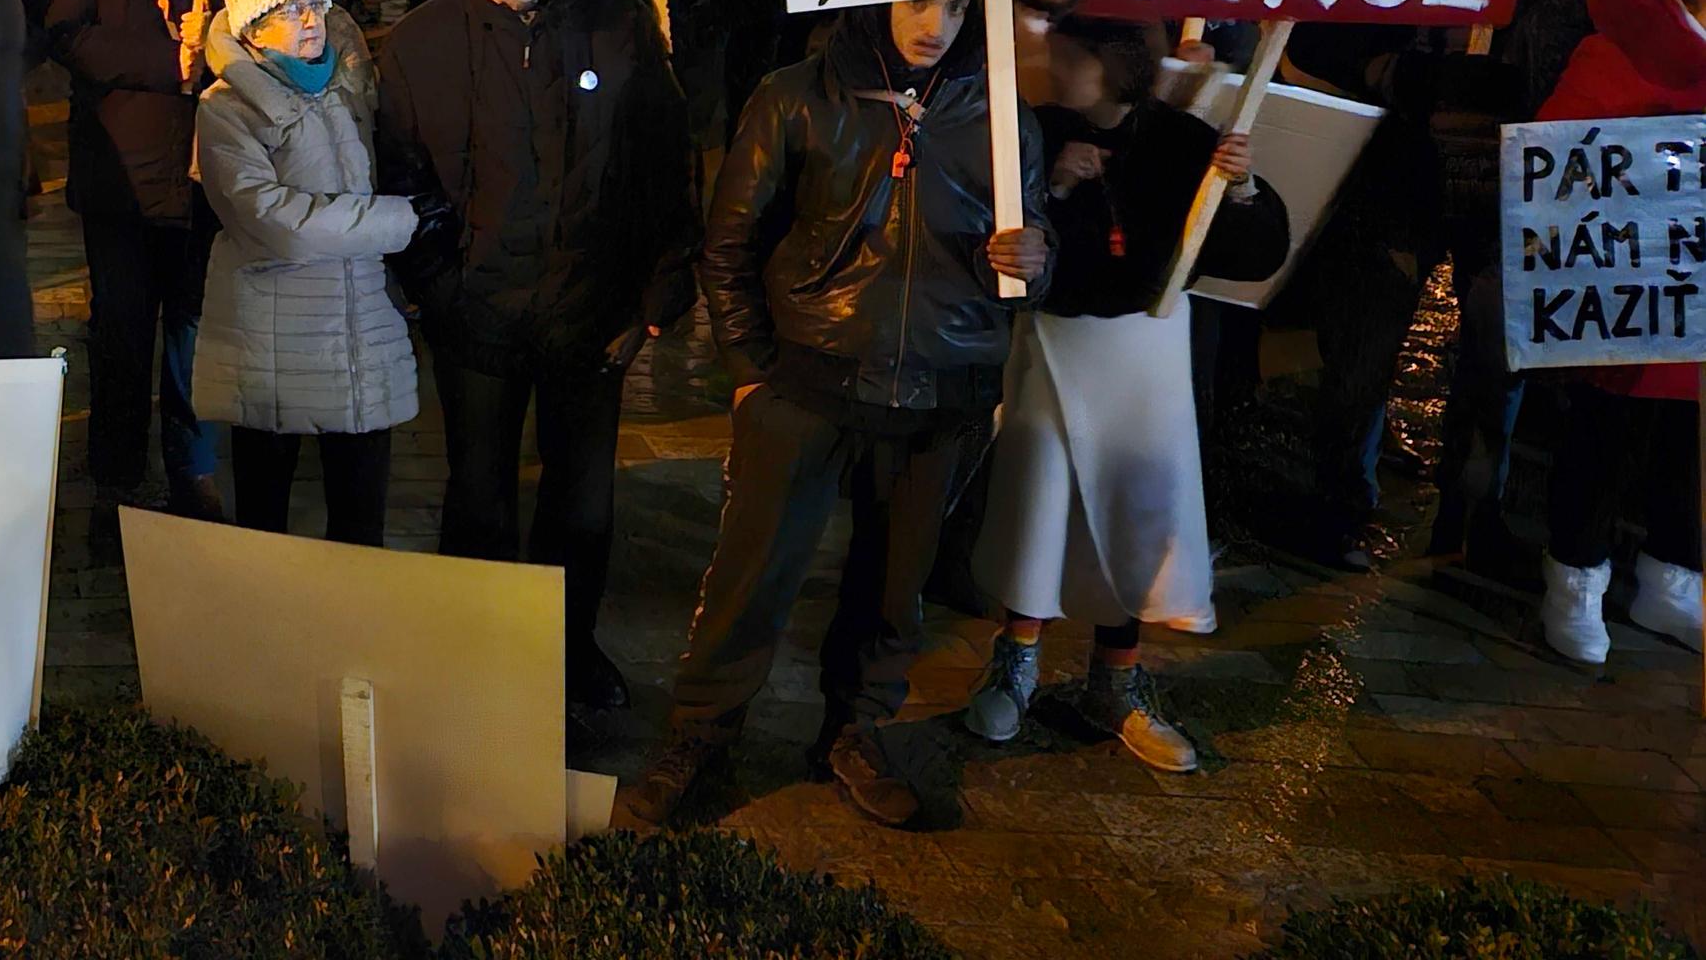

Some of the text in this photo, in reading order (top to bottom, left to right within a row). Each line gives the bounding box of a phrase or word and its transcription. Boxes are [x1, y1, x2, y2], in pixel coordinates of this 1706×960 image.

[1521, 126, 1640, 202] PÁR
[1522, 210, 1642, 272] NÁM
[1530, 268, 1699, 344] KAZIŤ
